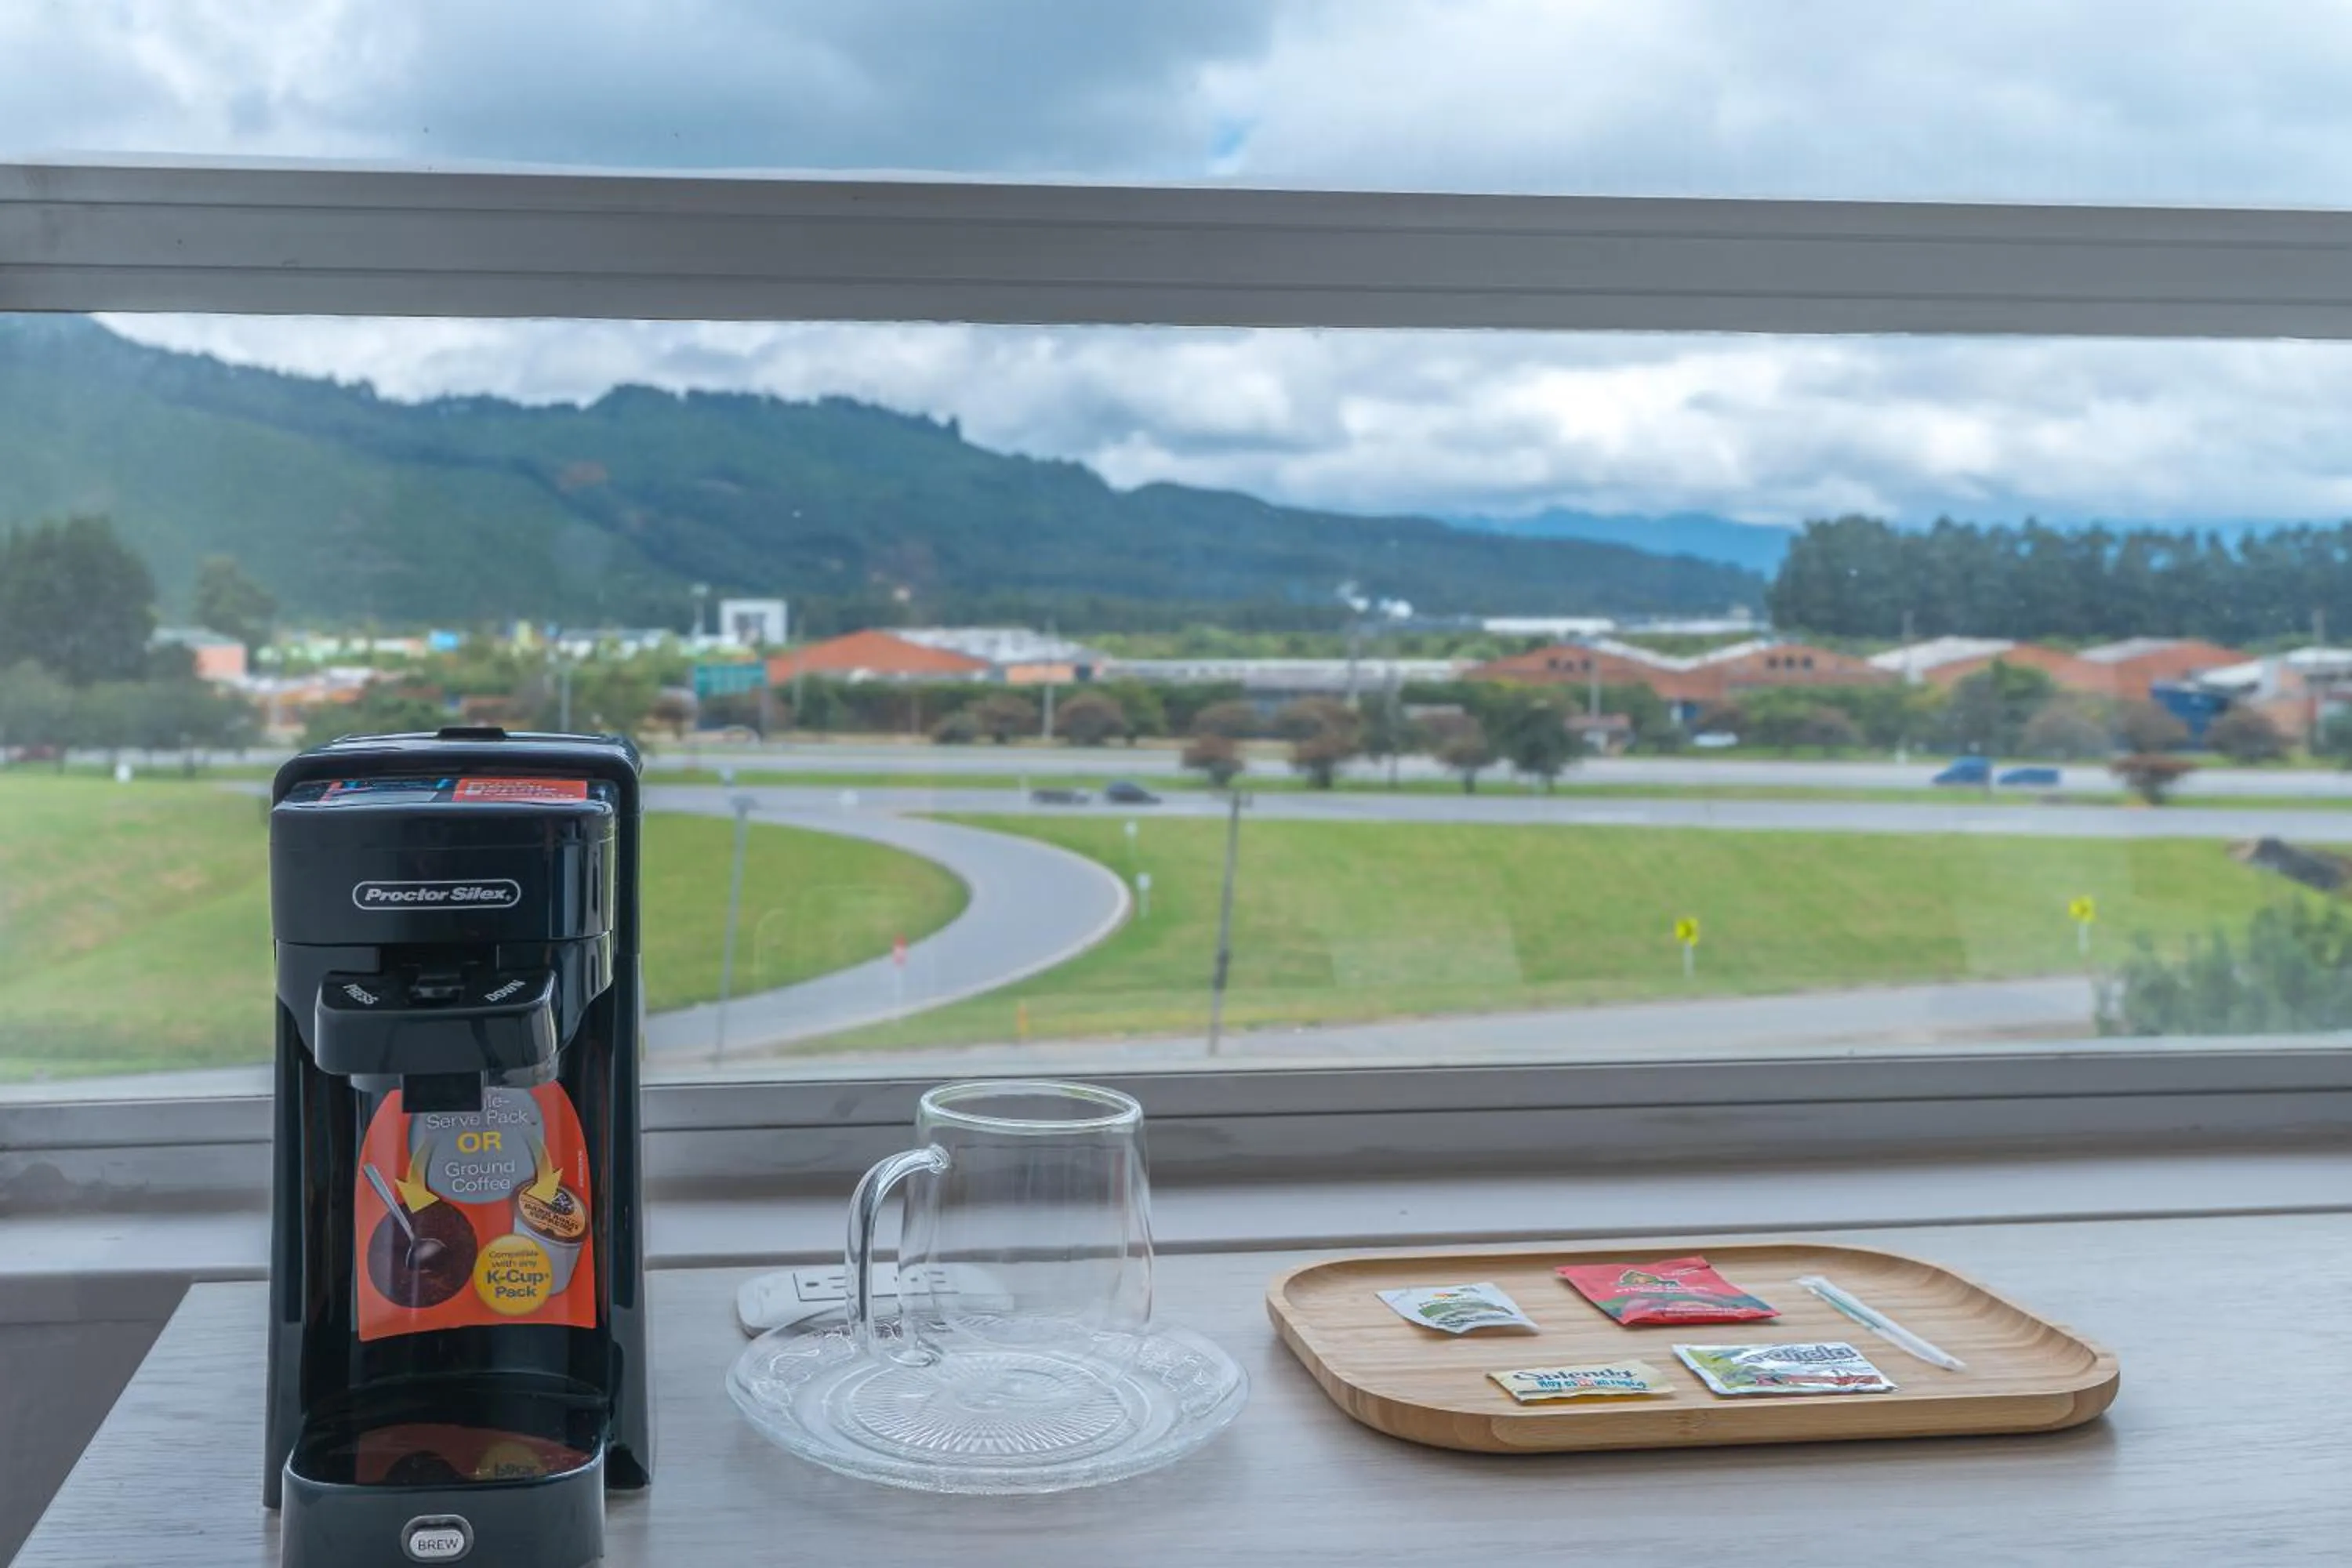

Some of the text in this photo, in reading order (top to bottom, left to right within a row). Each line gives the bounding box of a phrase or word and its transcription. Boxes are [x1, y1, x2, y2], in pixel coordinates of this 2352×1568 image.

[365, 887, 506, 902] Proctor Silex
[342, 983, 379, 1005] PRESS
[485, 979, 526, 1004] DOWN
[426, 1109, 529, 1130] Serve Pack
[456, 1131, 503, 1154] OR
[445, 1160, 516, 1177] Ground
[452, 1177, 510, 1192] Coffee
[495, 1286, 538, 1299] Pack
[418, 1537, 459, 1551] BREW
